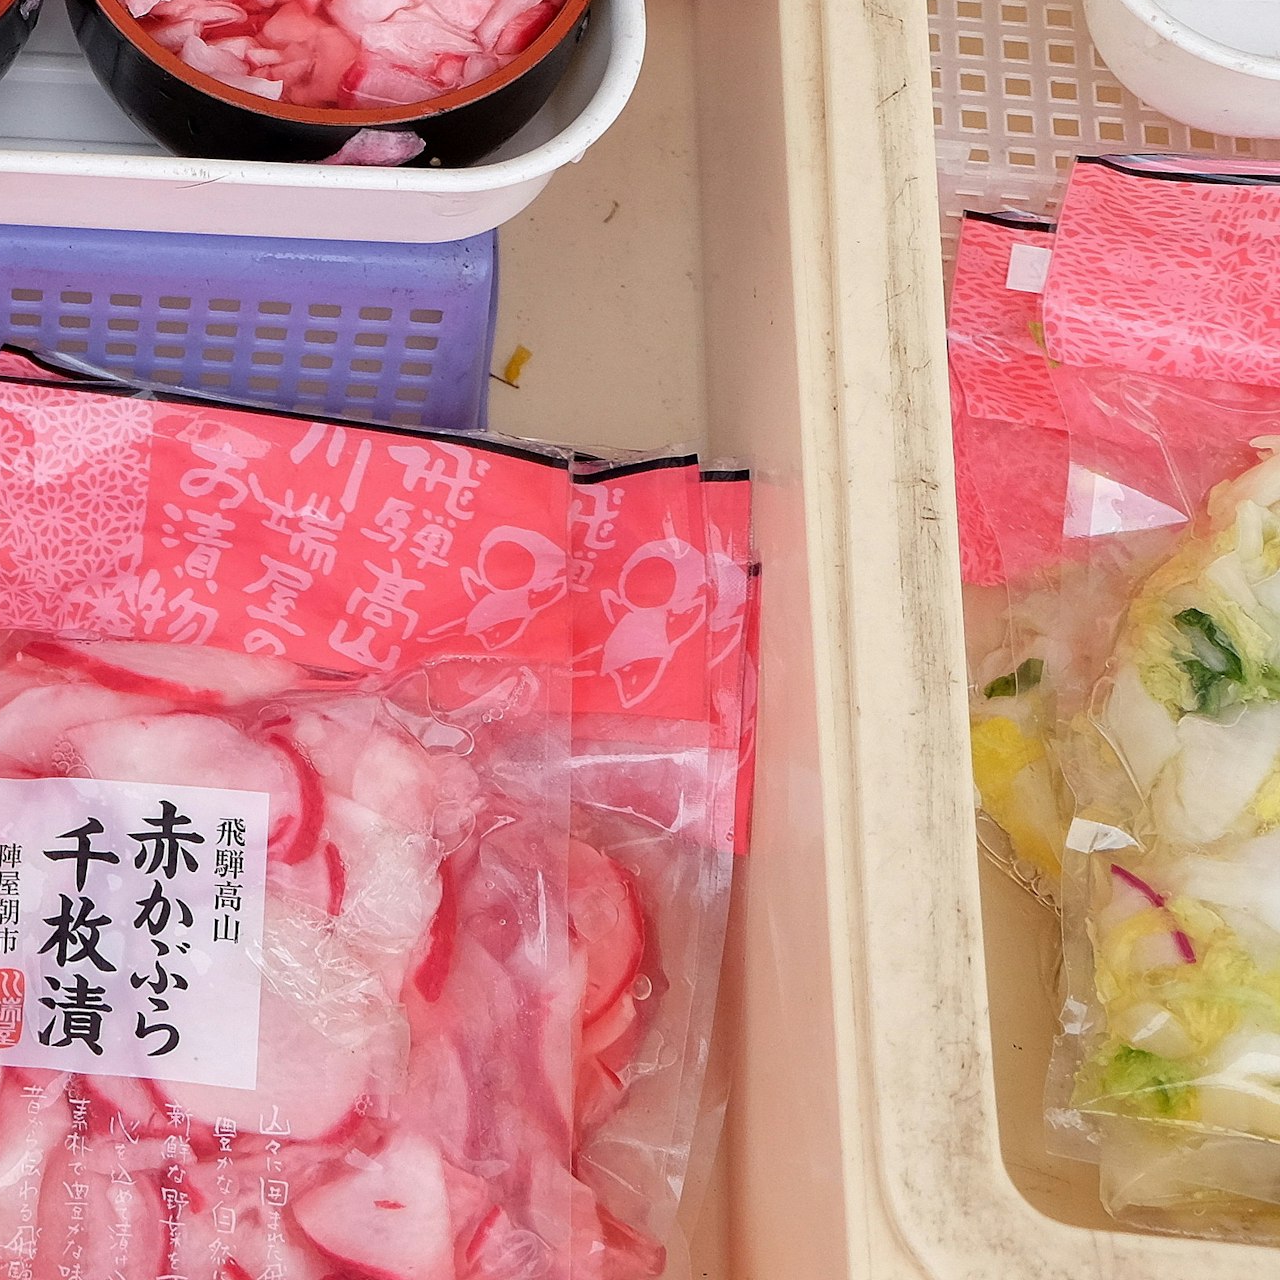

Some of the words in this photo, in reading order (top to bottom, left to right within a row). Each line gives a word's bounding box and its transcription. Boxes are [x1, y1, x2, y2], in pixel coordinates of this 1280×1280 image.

[138, 443, 250, 646] お漬物
[244, 423, 373, 658] 川端屋の
[329, 439, 491, 671] 飛騨高山
[37, 817, 120, 1056] 千枚漬
[127, 800, 205, 1056] 赤かぶら
[213, 817, 246, 943] 飛騨高山
